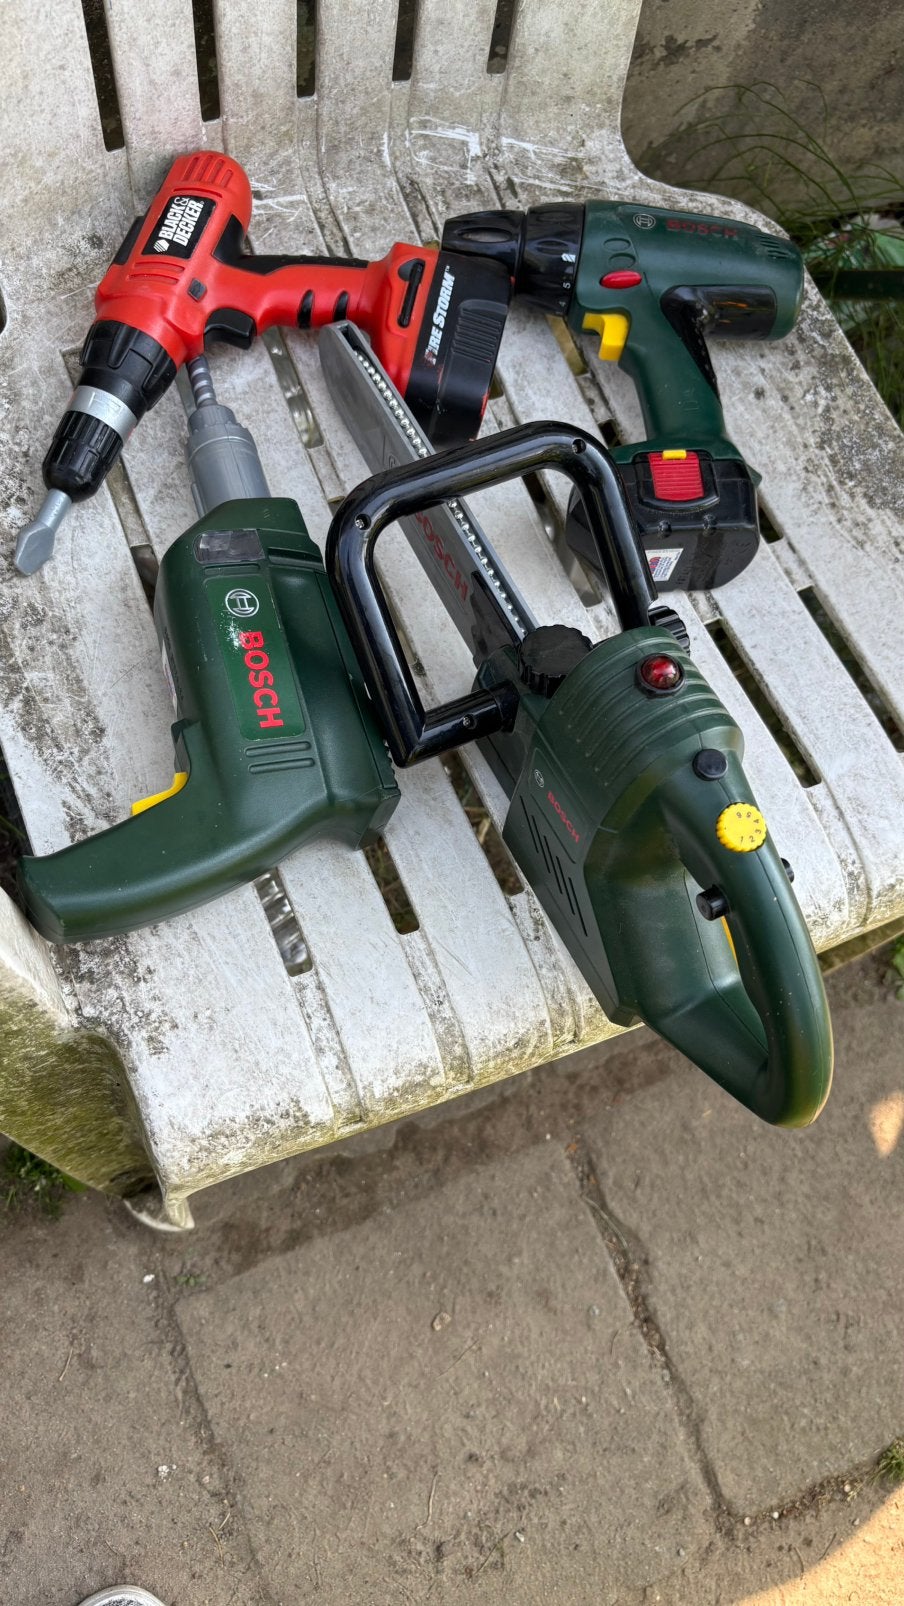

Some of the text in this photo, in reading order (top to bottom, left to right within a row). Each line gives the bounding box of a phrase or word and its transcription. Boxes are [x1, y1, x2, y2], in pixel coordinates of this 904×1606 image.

[172, 199, 204, 247] DECKER
[666, 220, 738, 239] BOSCH
[433, 271, 455, 329] STORM
[239, 631, 284, 728] BOSCH
[547, 791, 580, 843] BOSCH
